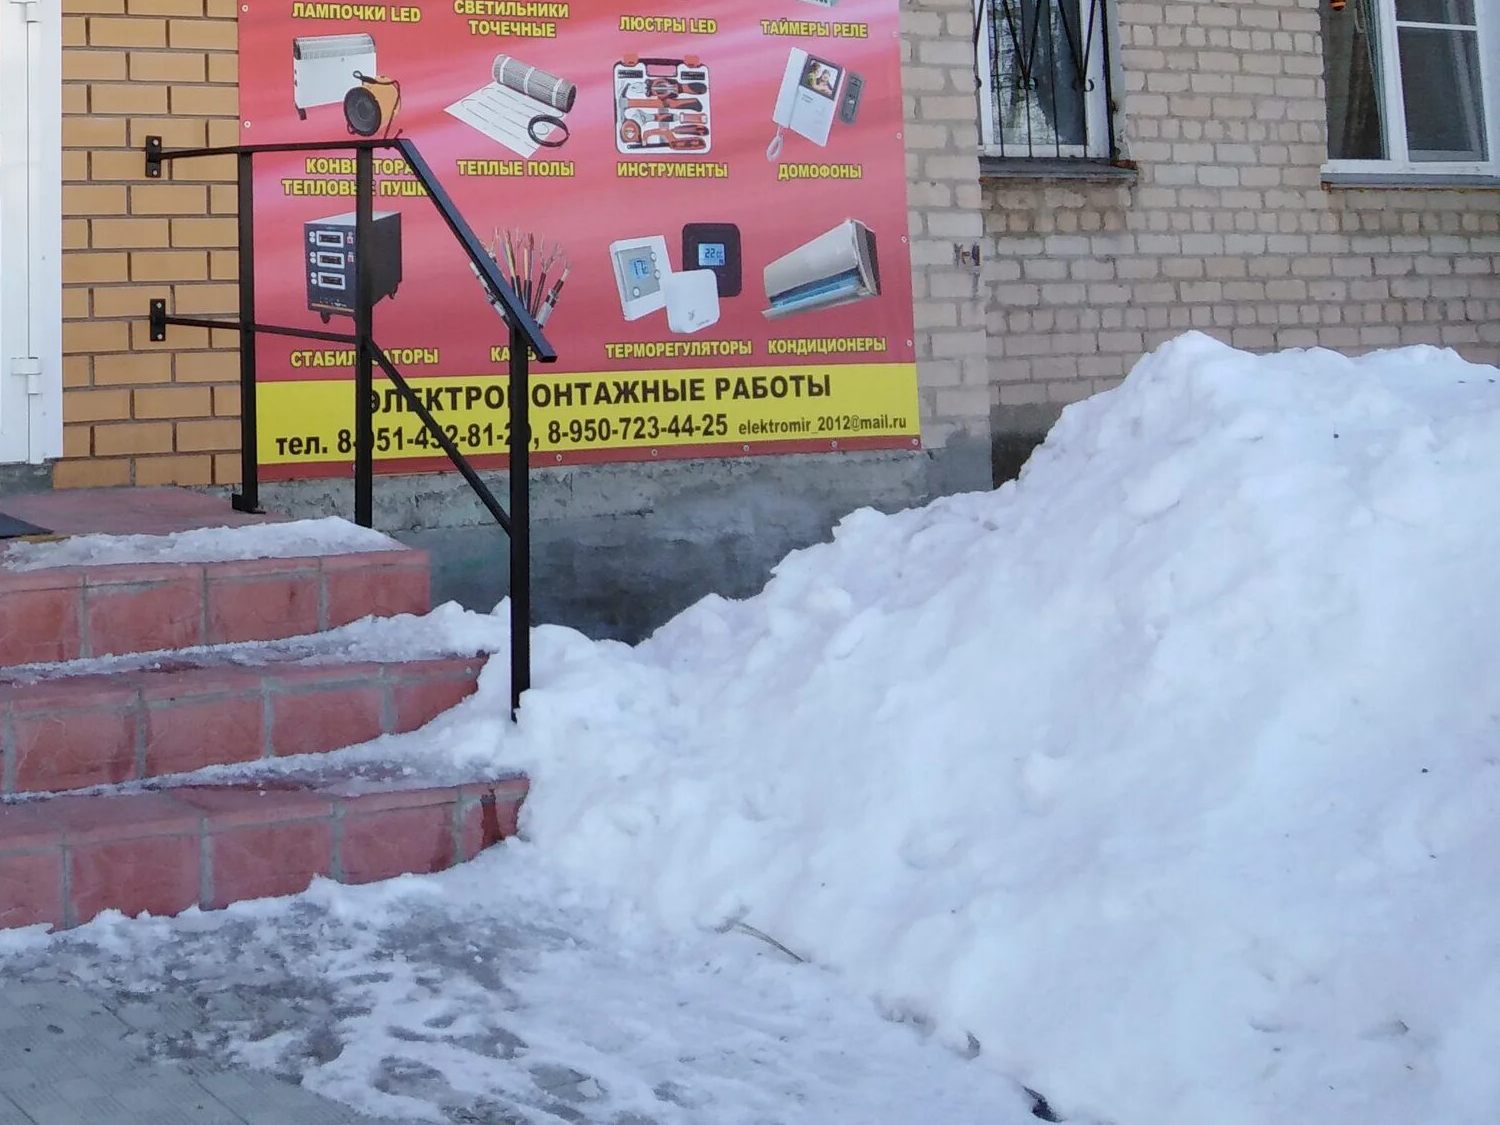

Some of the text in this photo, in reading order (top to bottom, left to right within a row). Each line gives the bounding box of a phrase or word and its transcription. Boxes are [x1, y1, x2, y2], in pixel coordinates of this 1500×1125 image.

[292, 2, 421, 22] ЛАМПОЧКИ LED
[468, 19, 556, 38] ТОЧЕЧНЫЕ
[619, 16, 717, 34] ЛЮСТРЫ LED
[761, 19, 868, 38] ТАЙМЕРЫ РЕЛЕ
[305, 158, 415, 174] КОНВТОРА
[456, 160, 575, 177] ТЕПЛЫЕ ПОЛЫ
[617, 162, 728, 178] ИНСТРУМЕНТЫ
[778, 163, 862, 180] ДОМОФОНЫ
[380, 180, 429, 196] ПУШК
[605, 340, 752, 359] ТЕРМОРЕГУЛЯТОРЫ
[768, 337, 886, 356] КОНДИЦИОНЕРЫ
[290, 348, 440, 368] СТАБИЛАТОРЫ
[715, 374, 831, 401] РАБОТЫ
[276, 435, 328, 456] тел.
[548, 413, 728, 444] 8-950-723-44-25
[738, 415, 907, 436] elektromir_2012@mail.ru
